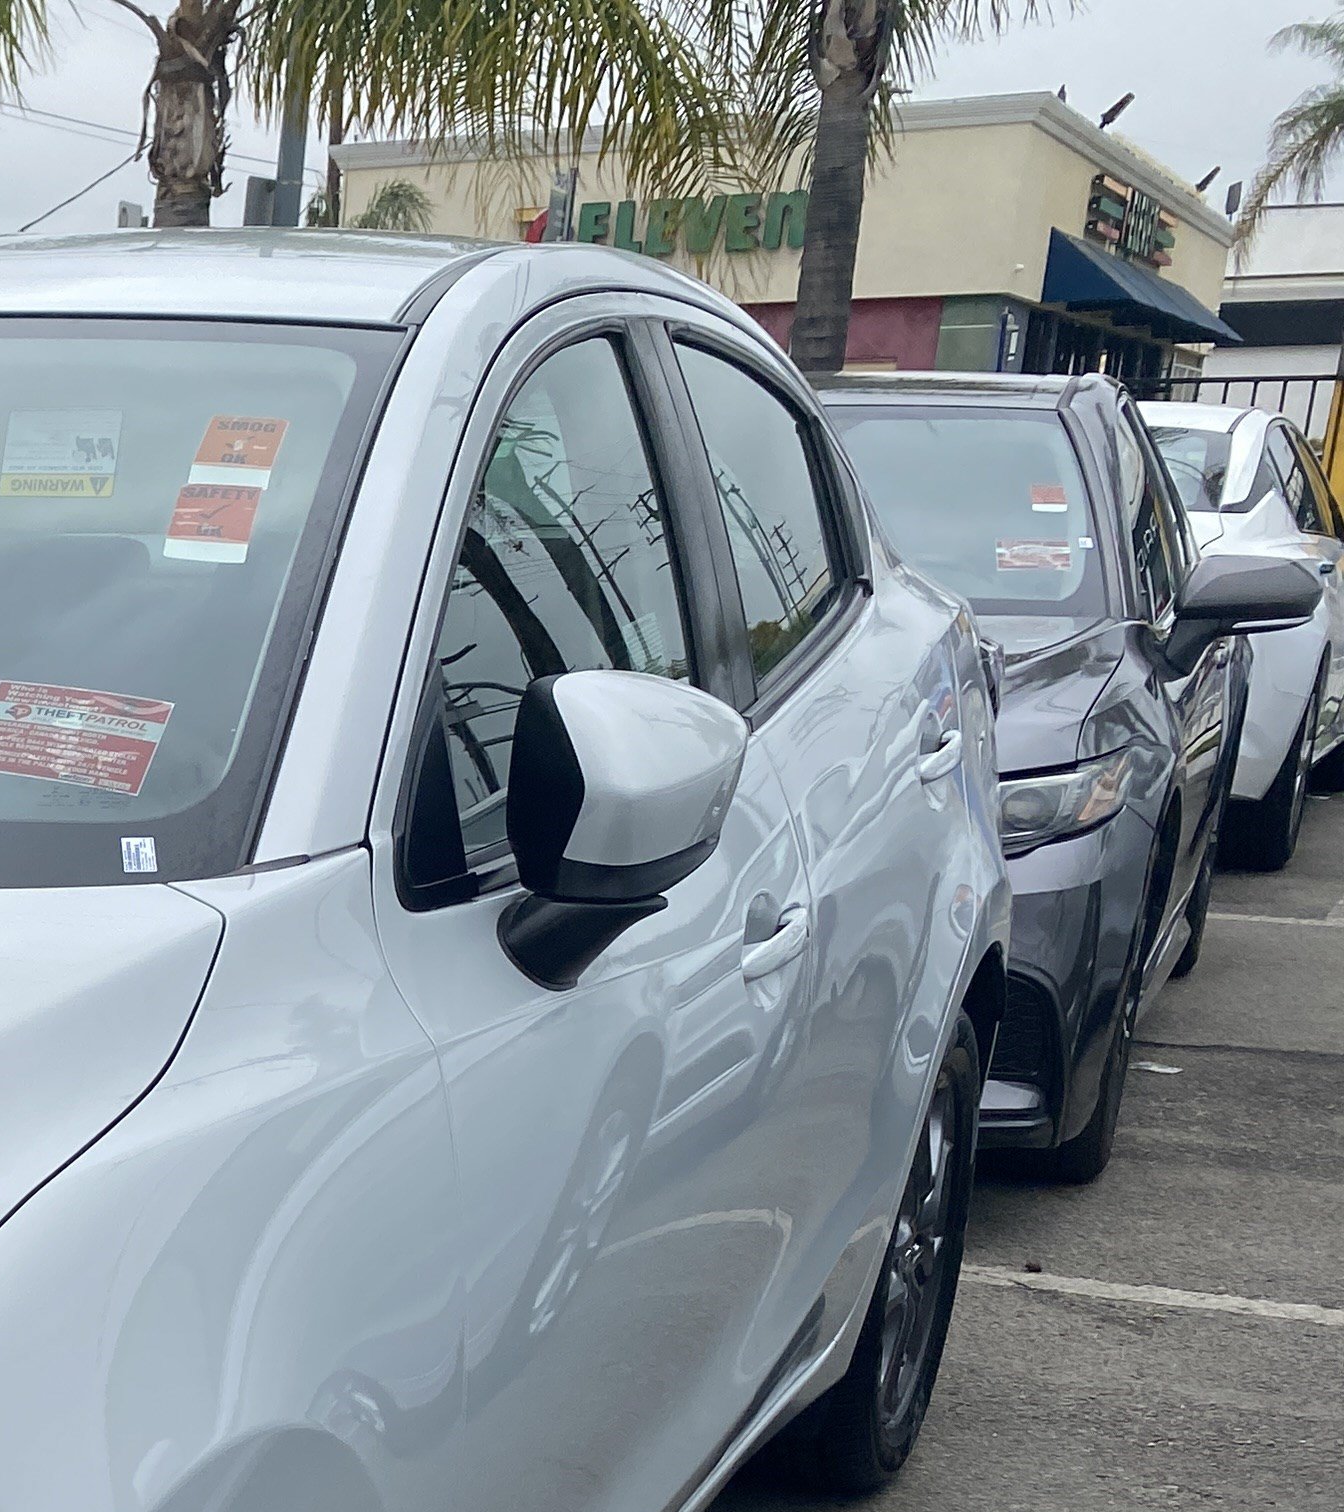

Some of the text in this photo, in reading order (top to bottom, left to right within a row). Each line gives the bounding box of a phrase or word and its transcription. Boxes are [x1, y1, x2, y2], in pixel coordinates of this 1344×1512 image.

[217, 420, 278, 433] SMOG
[221, 453, 249, 464] OK
[10, 479, 85, 492] WARNING
[182, 486, 257, 500] SAFETY
